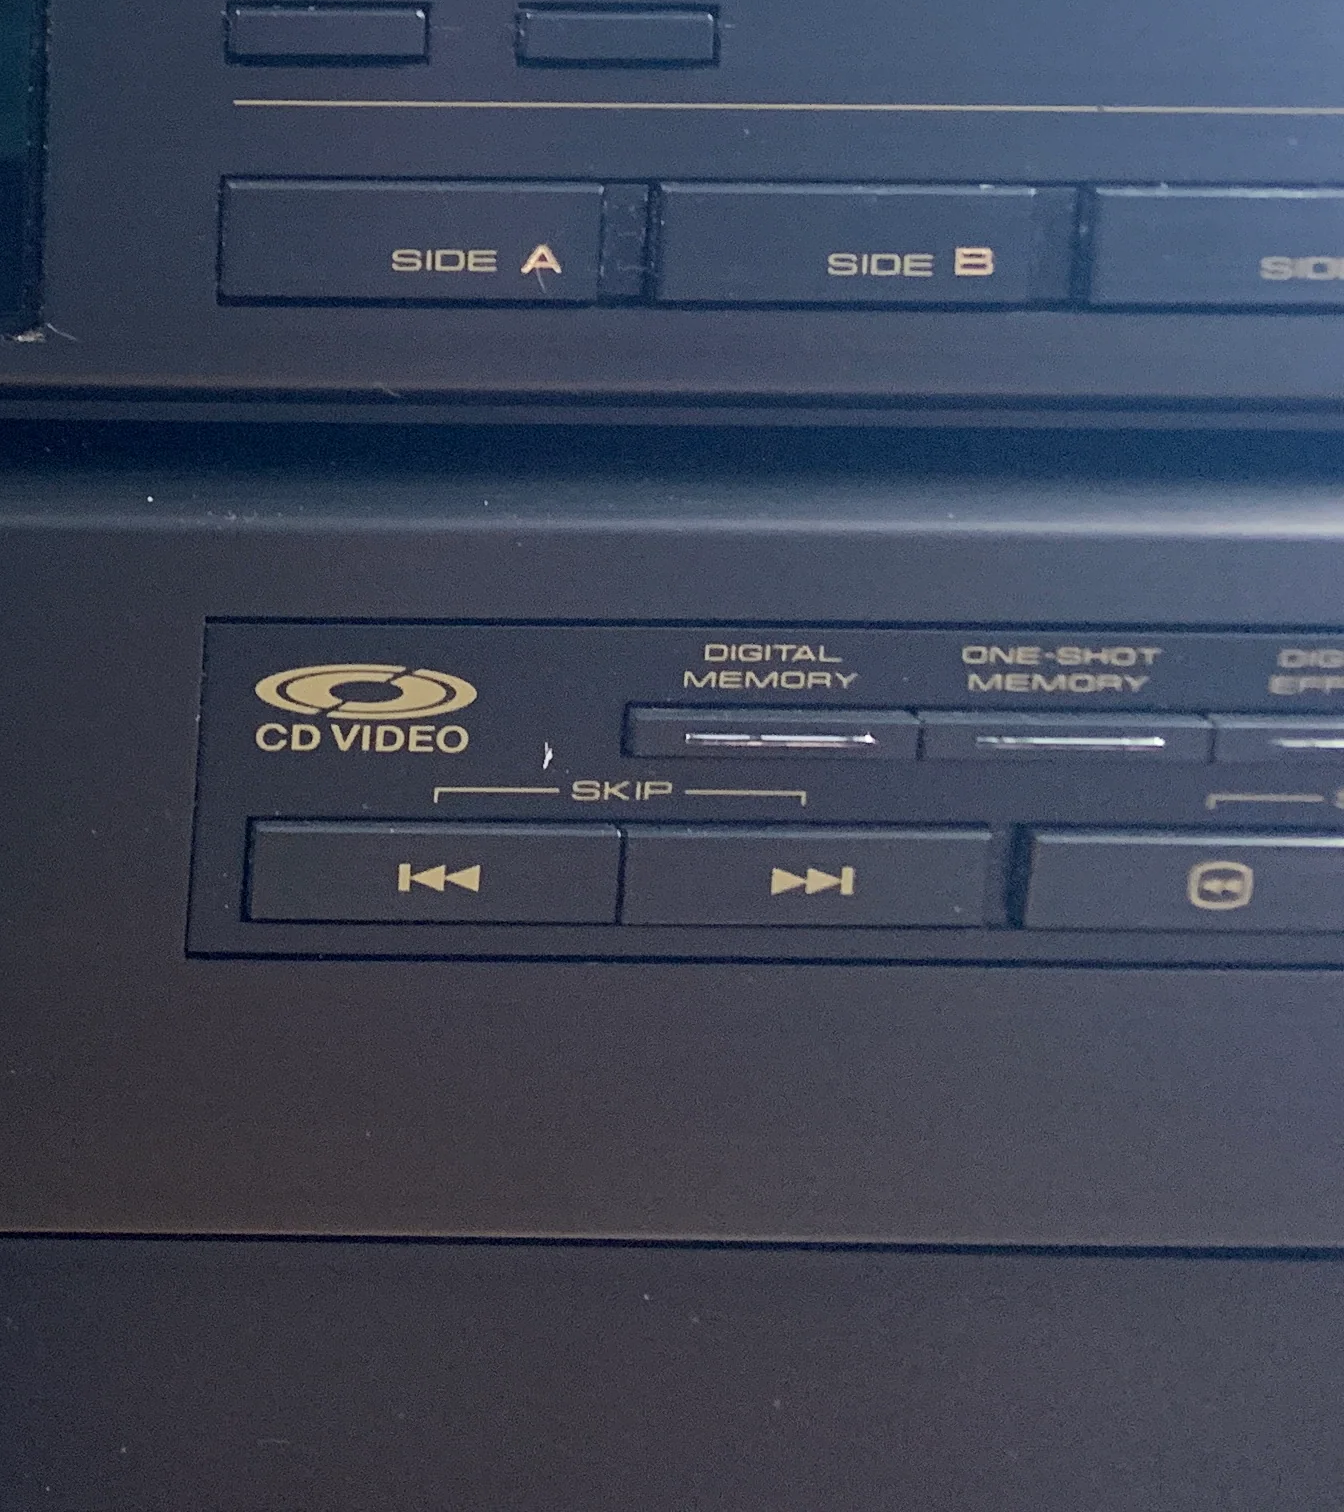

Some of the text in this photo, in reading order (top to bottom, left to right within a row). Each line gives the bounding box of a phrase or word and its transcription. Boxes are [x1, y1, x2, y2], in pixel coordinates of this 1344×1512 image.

[391, 244, 563, 274] SIDE A
[827, 247, 994, 277] SIDE B
[703, 644, 843, 663] DIGITAL
[961, 646, 1162, 666] ONE-SHOT
[683, 670, 859, 689] MEMORY
[967, 673, 1149, 693] MEMORY
[255, 724, 470, 754] CD VIDEO
[571, 780, 674, 801] SKIP
